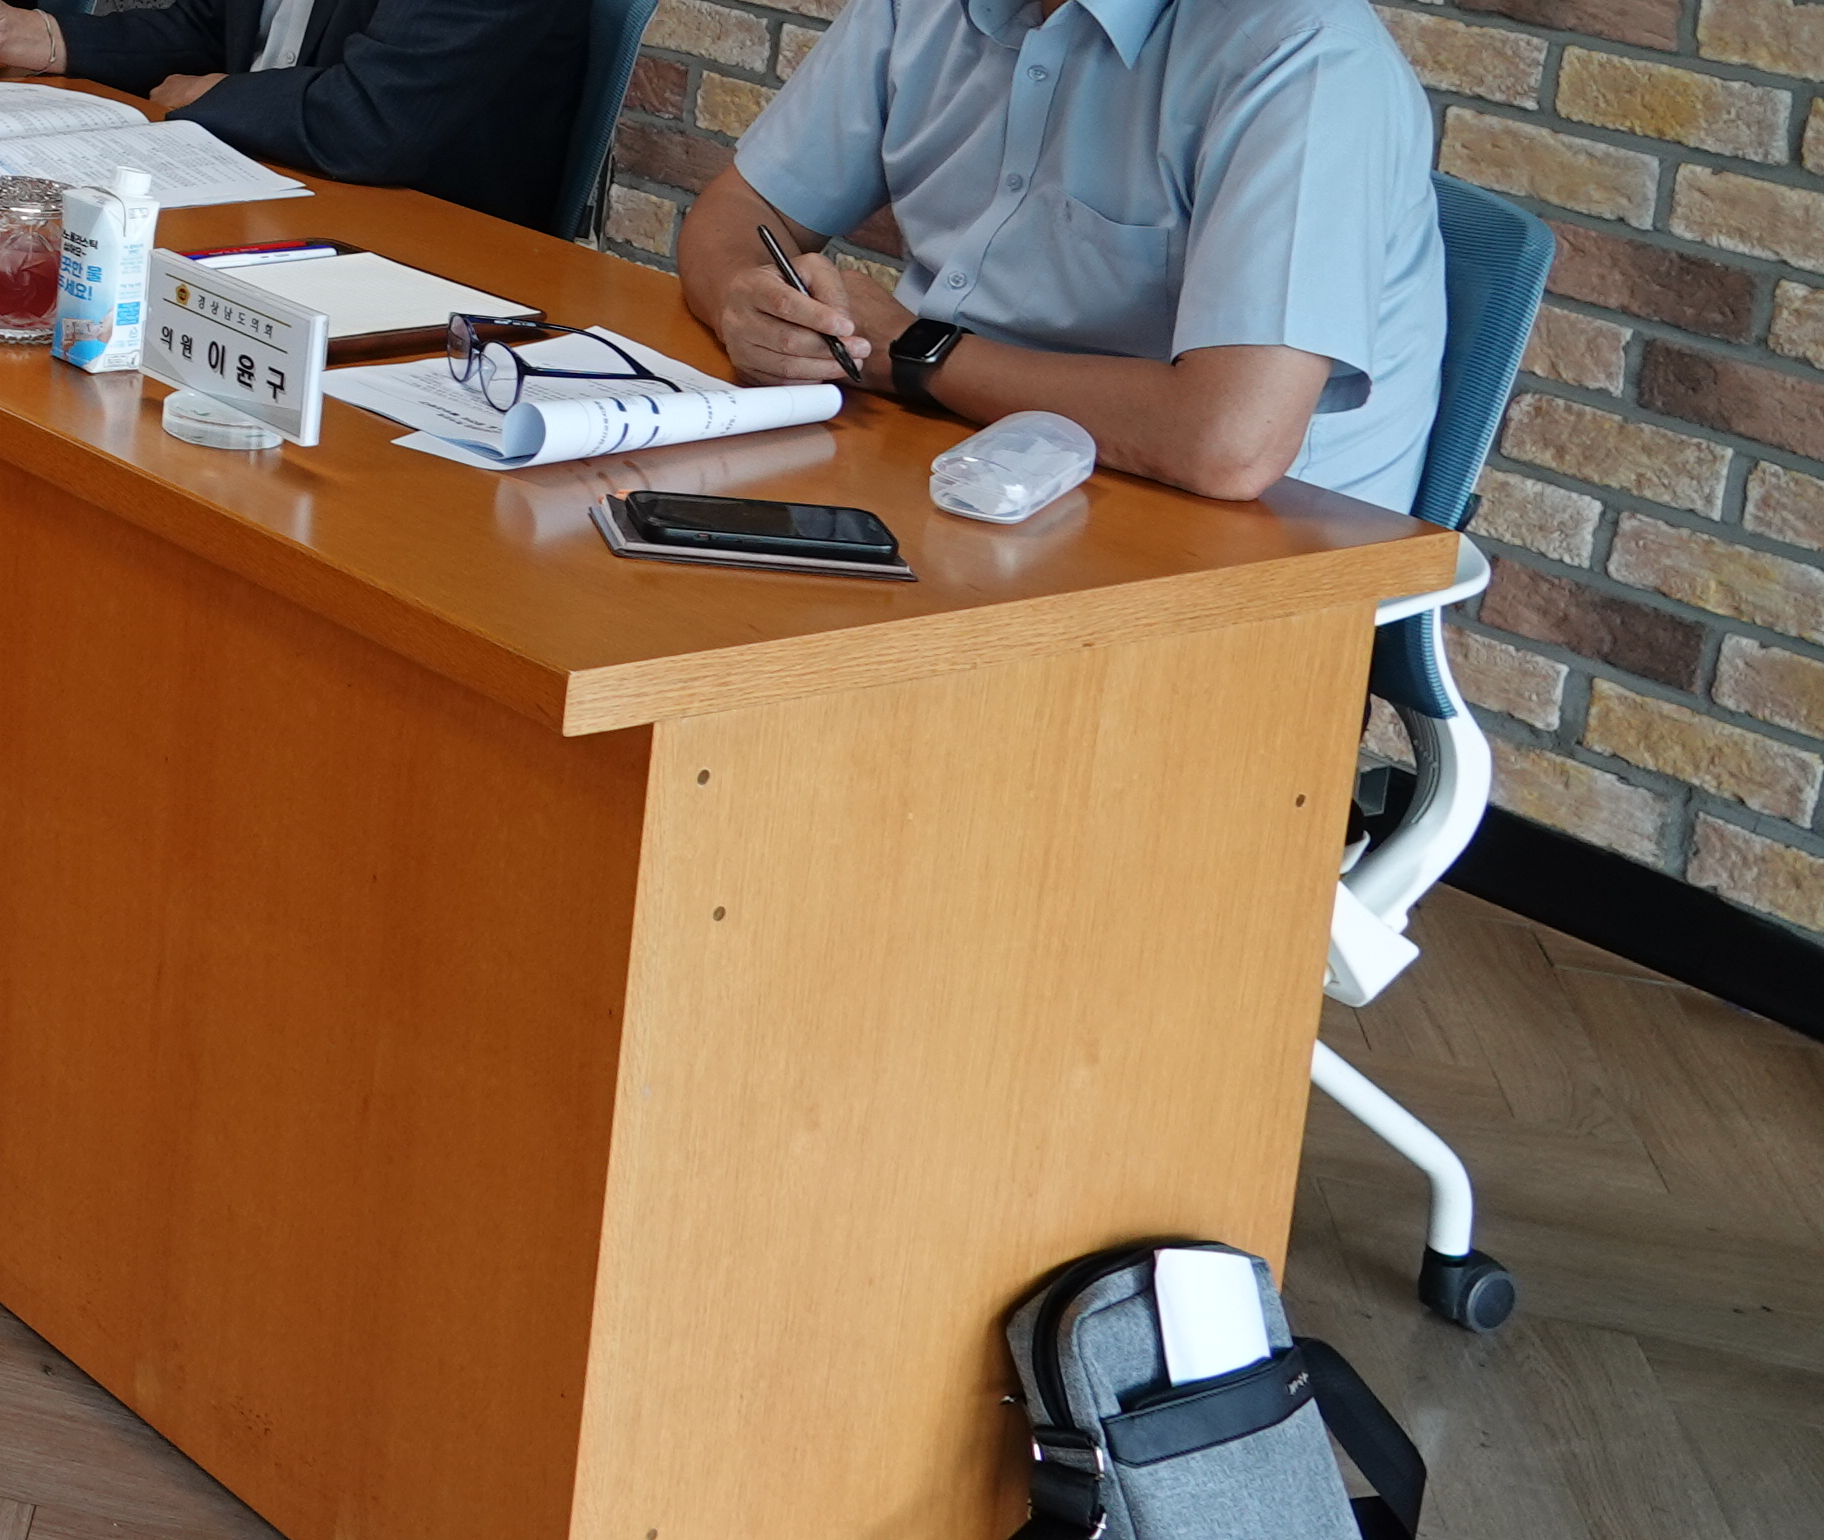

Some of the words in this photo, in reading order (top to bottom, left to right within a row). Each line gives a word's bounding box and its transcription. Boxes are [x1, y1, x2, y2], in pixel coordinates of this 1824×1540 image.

[197, 294, 274, 340] 경상남도의회
[160, 326, 193, 360] 의원
[208, 340, 286, 400] 이윤구
